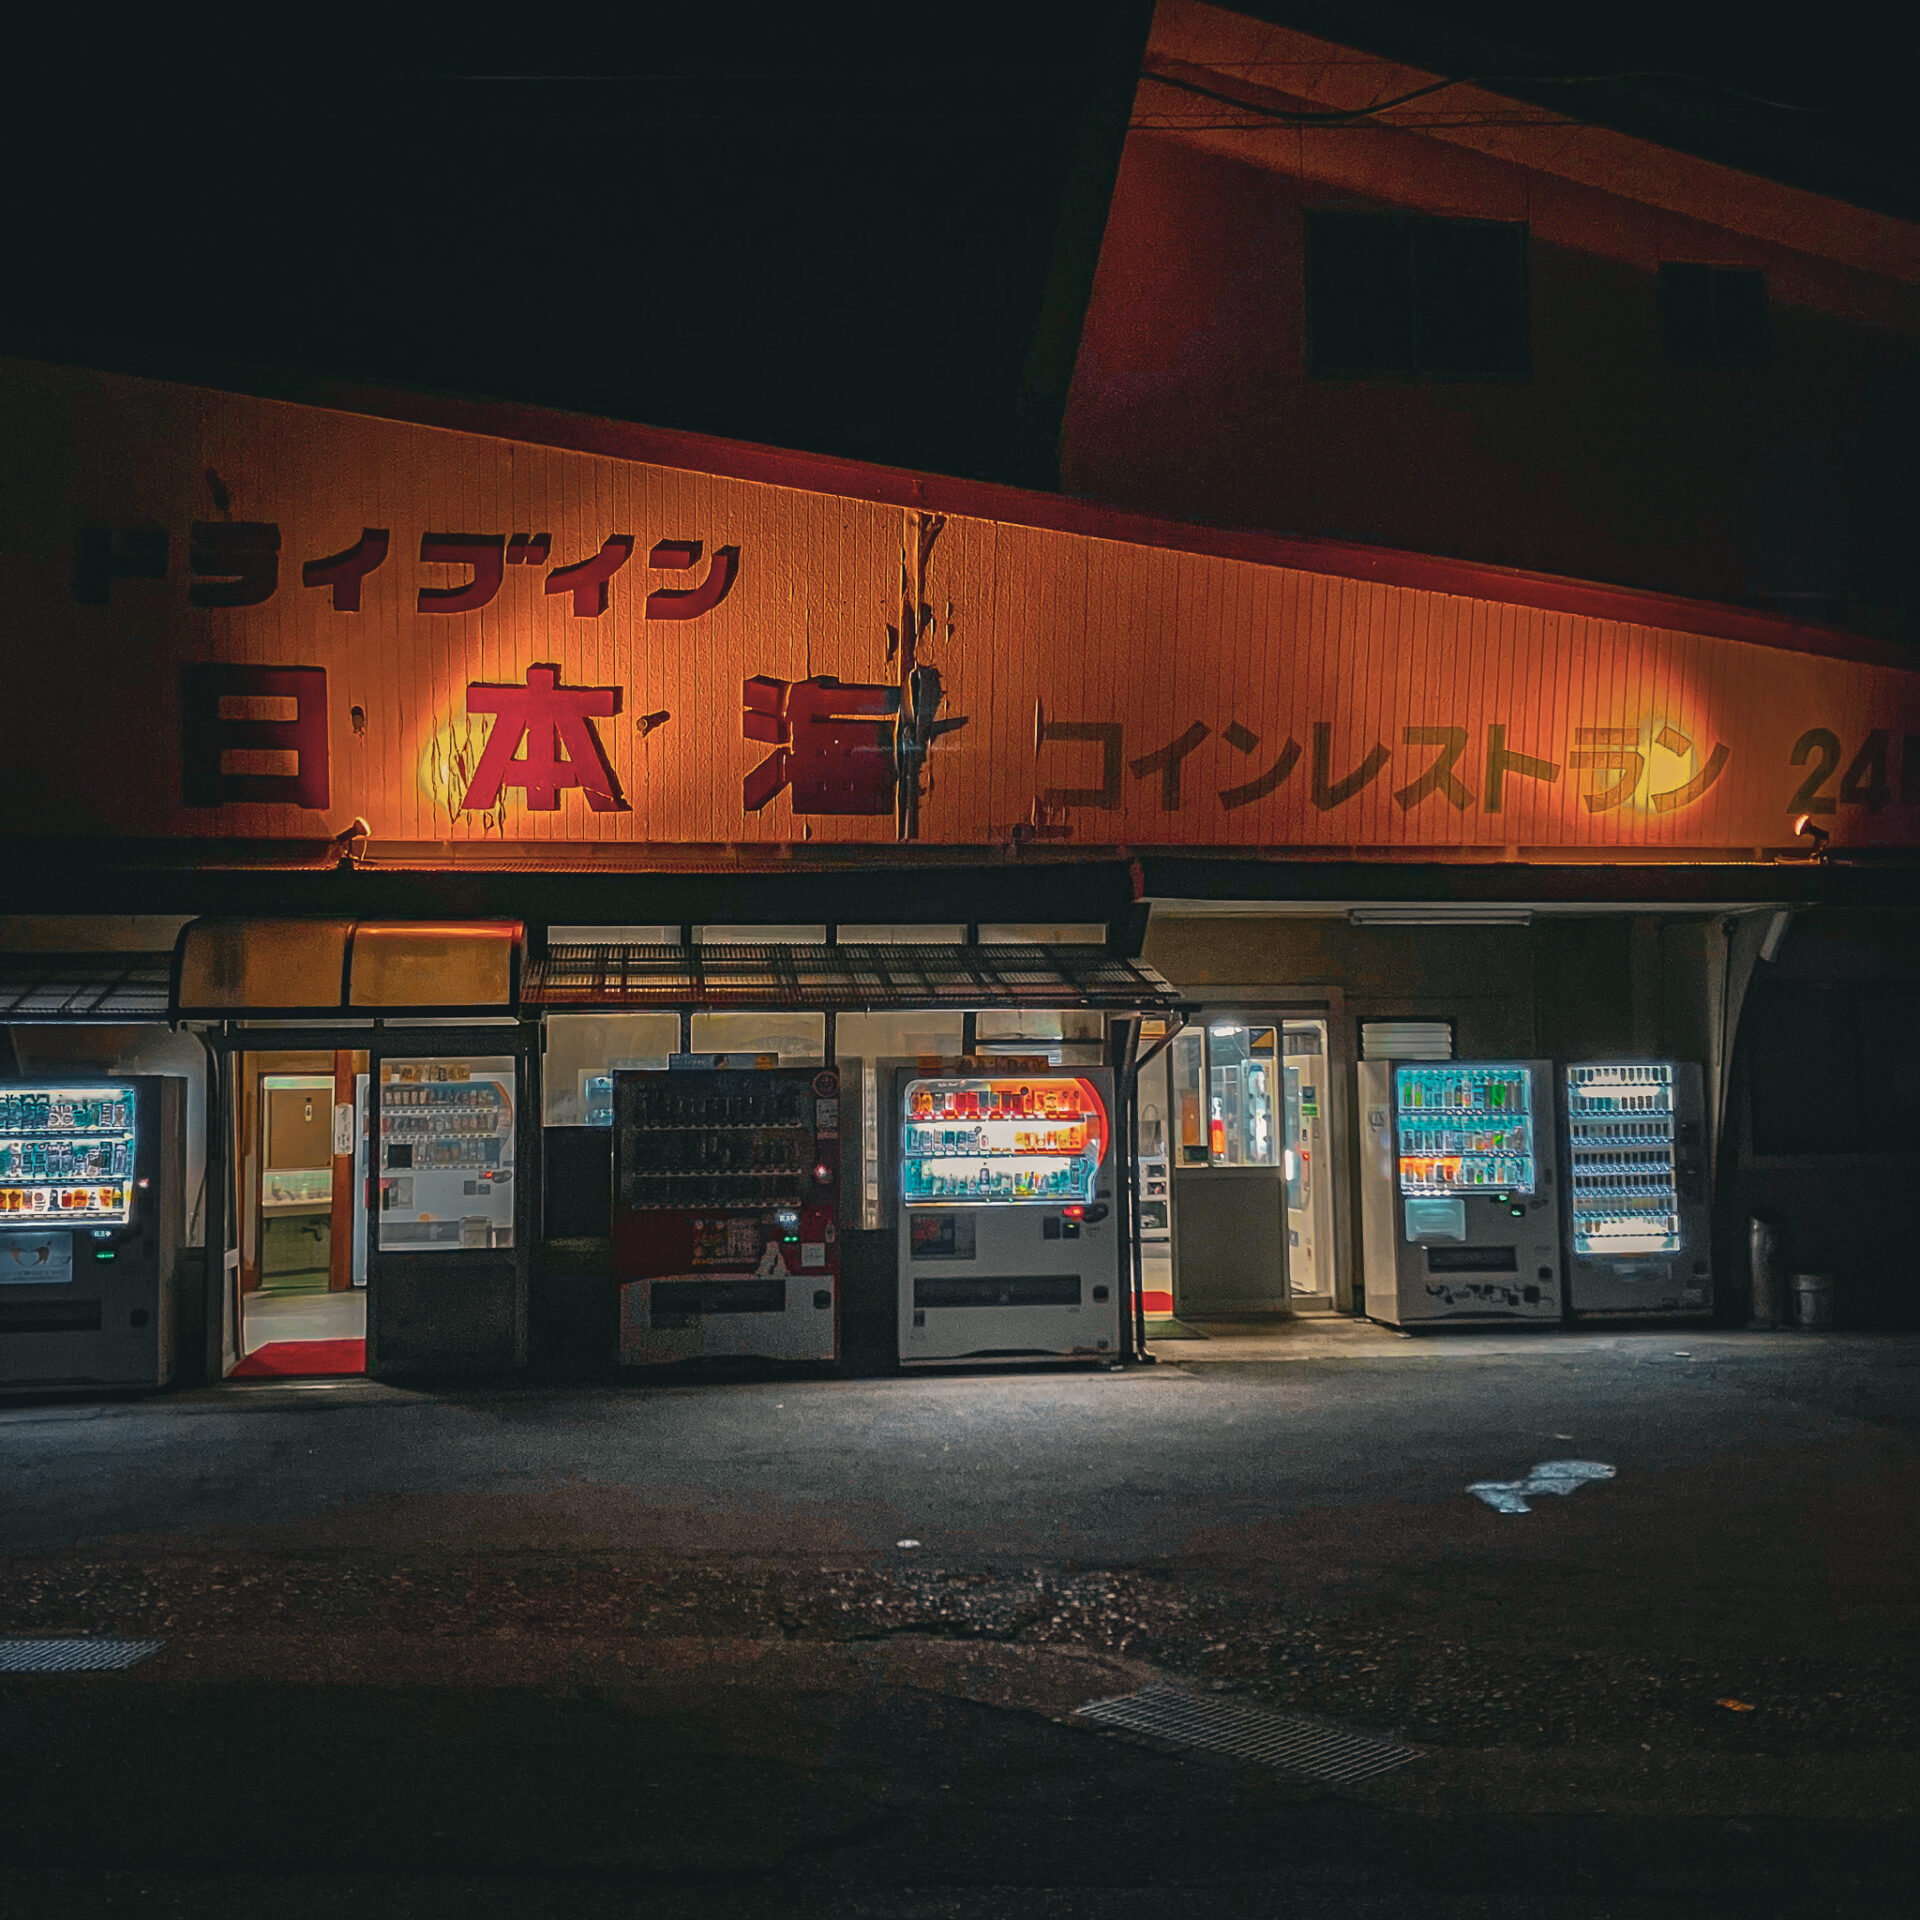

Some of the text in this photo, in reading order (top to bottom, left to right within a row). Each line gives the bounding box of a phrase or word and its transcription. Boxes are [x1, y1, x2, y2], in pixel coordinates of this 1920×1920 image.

[73, 519, 741, 620] ドライブイン
[1045, 720, 1920, 815] コインレストラン 24
